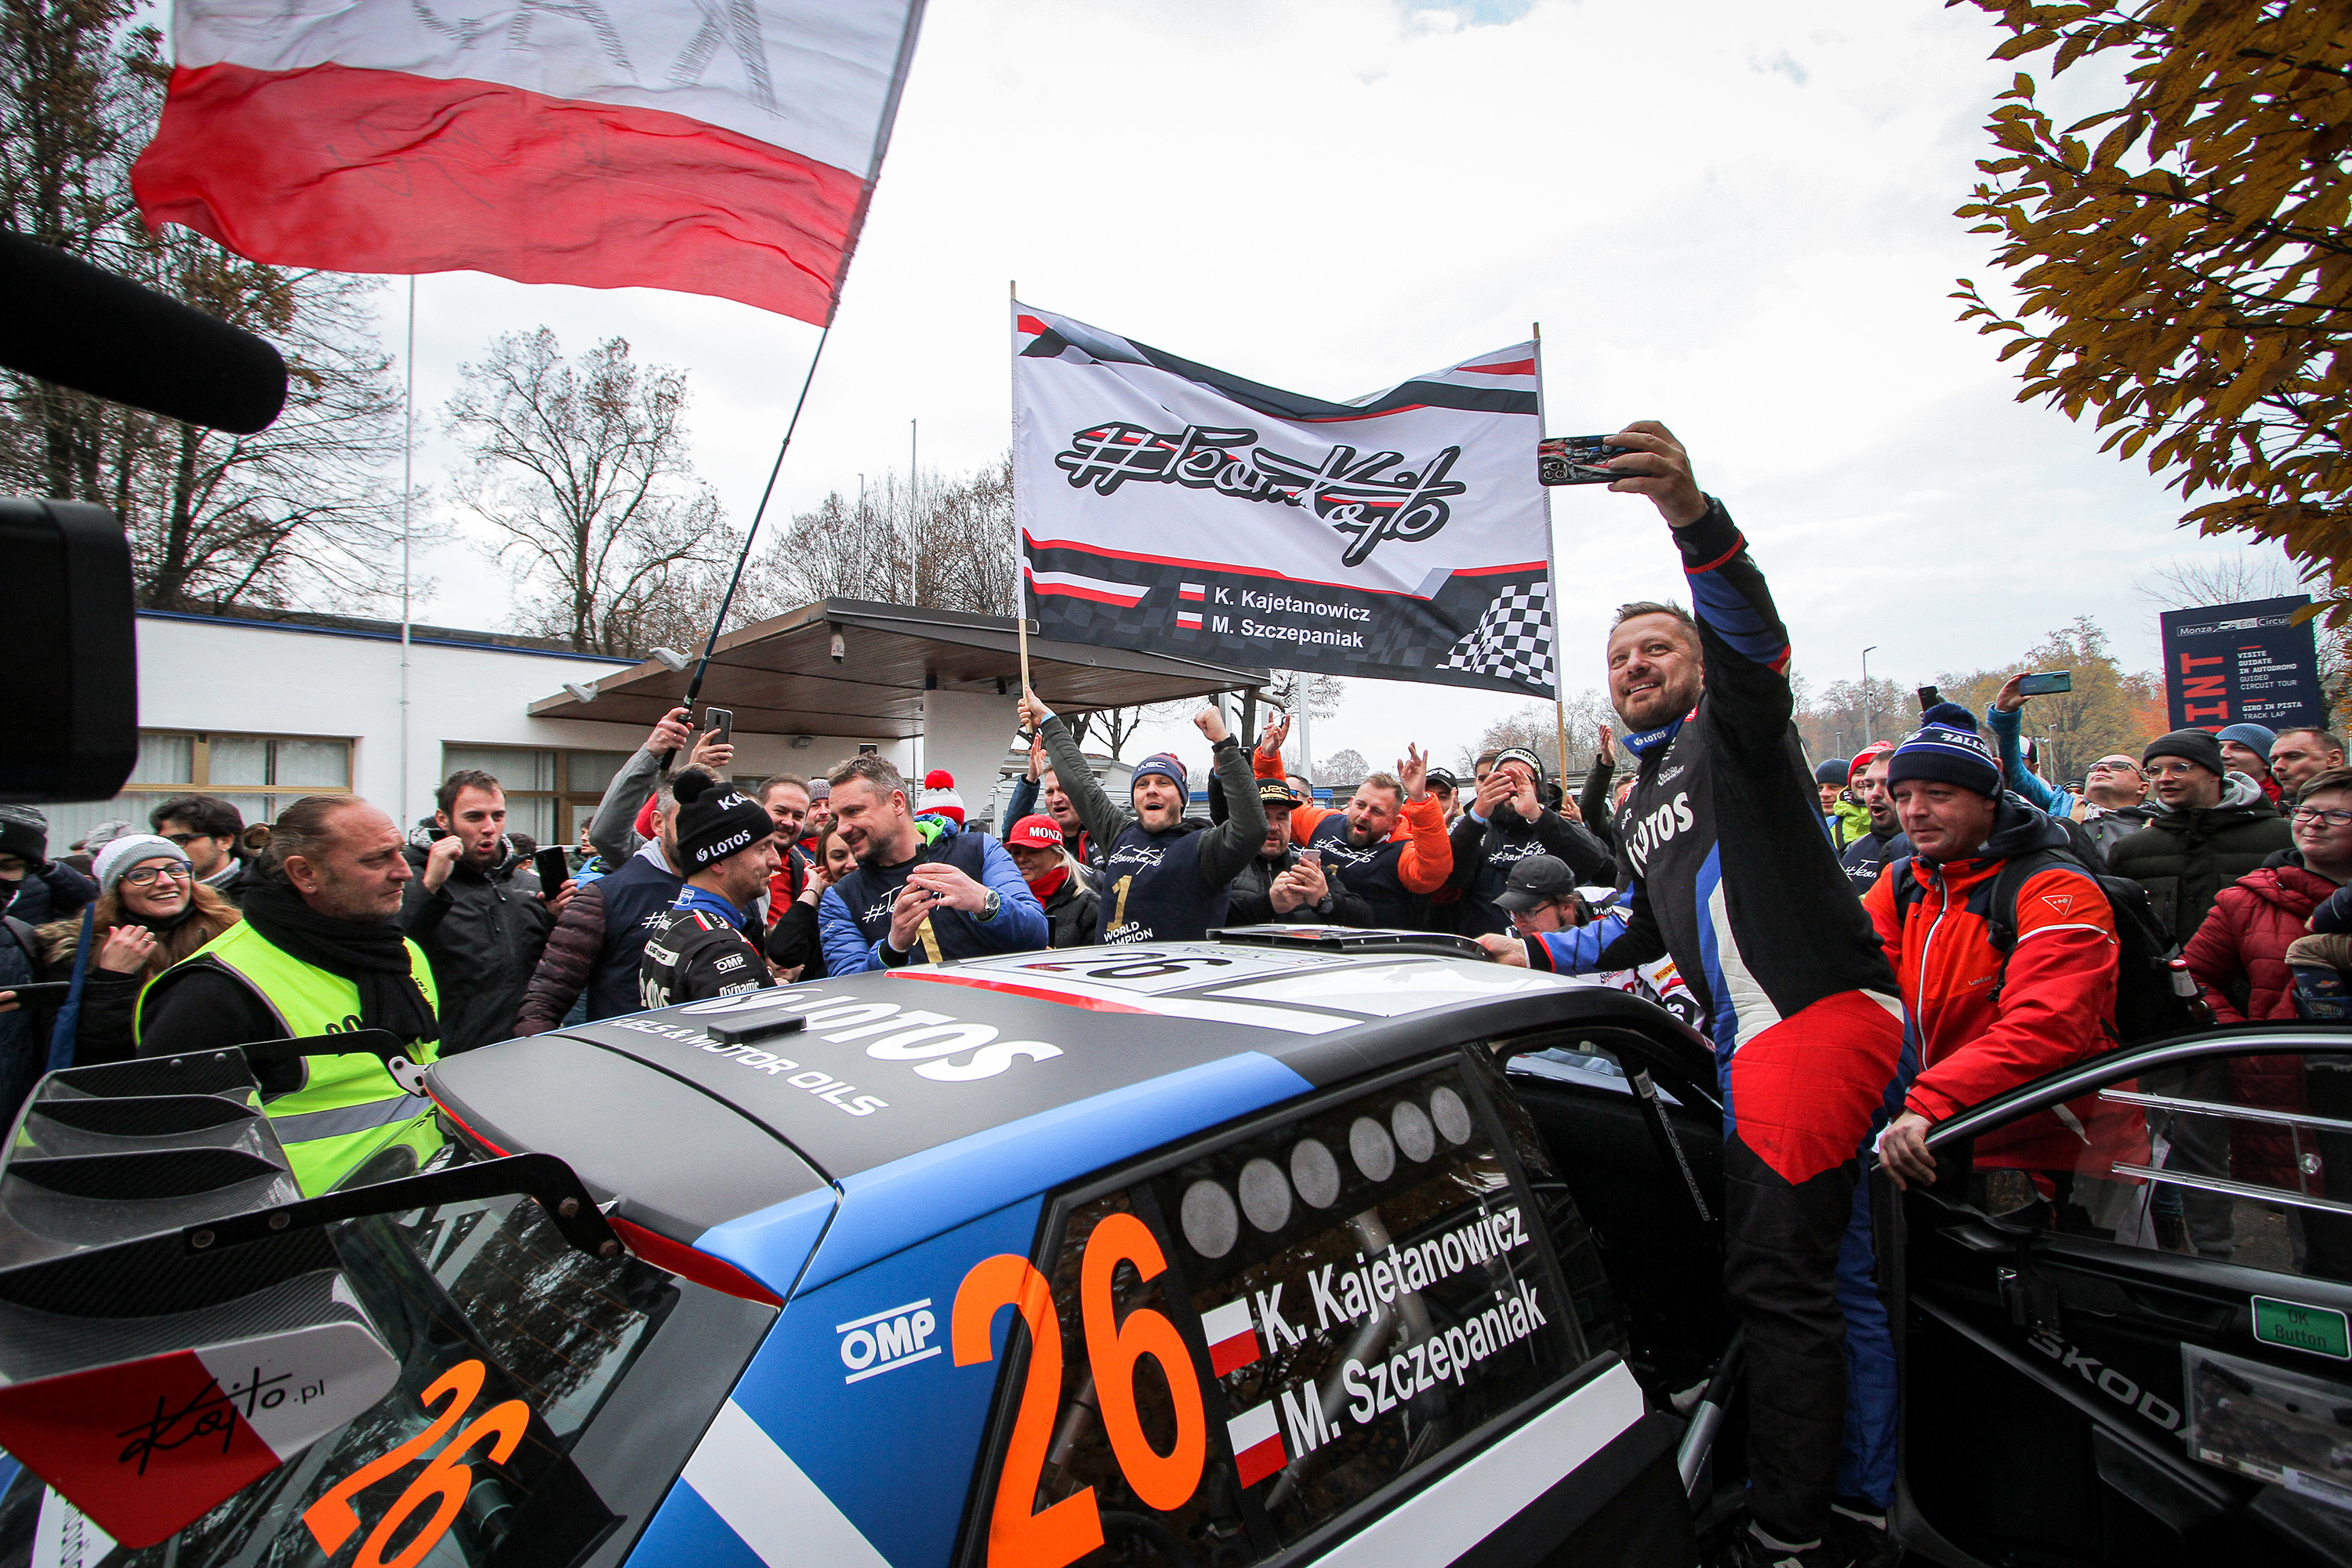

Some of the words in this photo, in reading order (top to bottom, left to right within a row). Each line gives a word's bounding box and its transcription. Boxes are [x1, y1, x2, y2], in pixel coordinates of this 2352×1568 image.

[1214, 586, 1235, 606] K.
[1241, 588, 1371, 622] Kajetanowicz
[1211, 615, 1235, 635] M.
[1240, 618, 1364, 648] Szczepaniak
[2180, 626, 2212, 635] Monza
[2239, 619, 2255, 628] Eni
[2238, 650, 2267, 659] VISITE
[2238, 658, 2273, 666] GUIDATE
[2252, 663, 2297, 673] AUTODROMO
[2239, 674, 2269, 683] GUIDED
[2240, 681, 2274, 691] CIRCUIT
[1643, 730, 1667, 742] LOTOS
[1138, 761, 1167, 771] WRC
[1259, 786, 1288, 795] WRC
[717, 791, 750, 811] KA
[710, 829, 751, 857] LOTOS
[1104, 921, 1140, 942] WORLD
[715, 956, 745, 971] OMP
[786, 1071, 889, 1117] OILS
[1255, 1281, 1307, 1353] K.
[1308, 1207, 1530, 1330] Kajetanowicz
[2288, 1308, 2309, 1326] OK
[840, 1309, 936, 1372] OMP
[2274, 1325, 2327, 1348] Button
[1281, 1381, 1341, 1459] M.
[1342, 1279, 1547, 1425] Szczepaniak
[951, 1213, 1206, 1568] 26
[302, 1359, 530, 1568] 26
